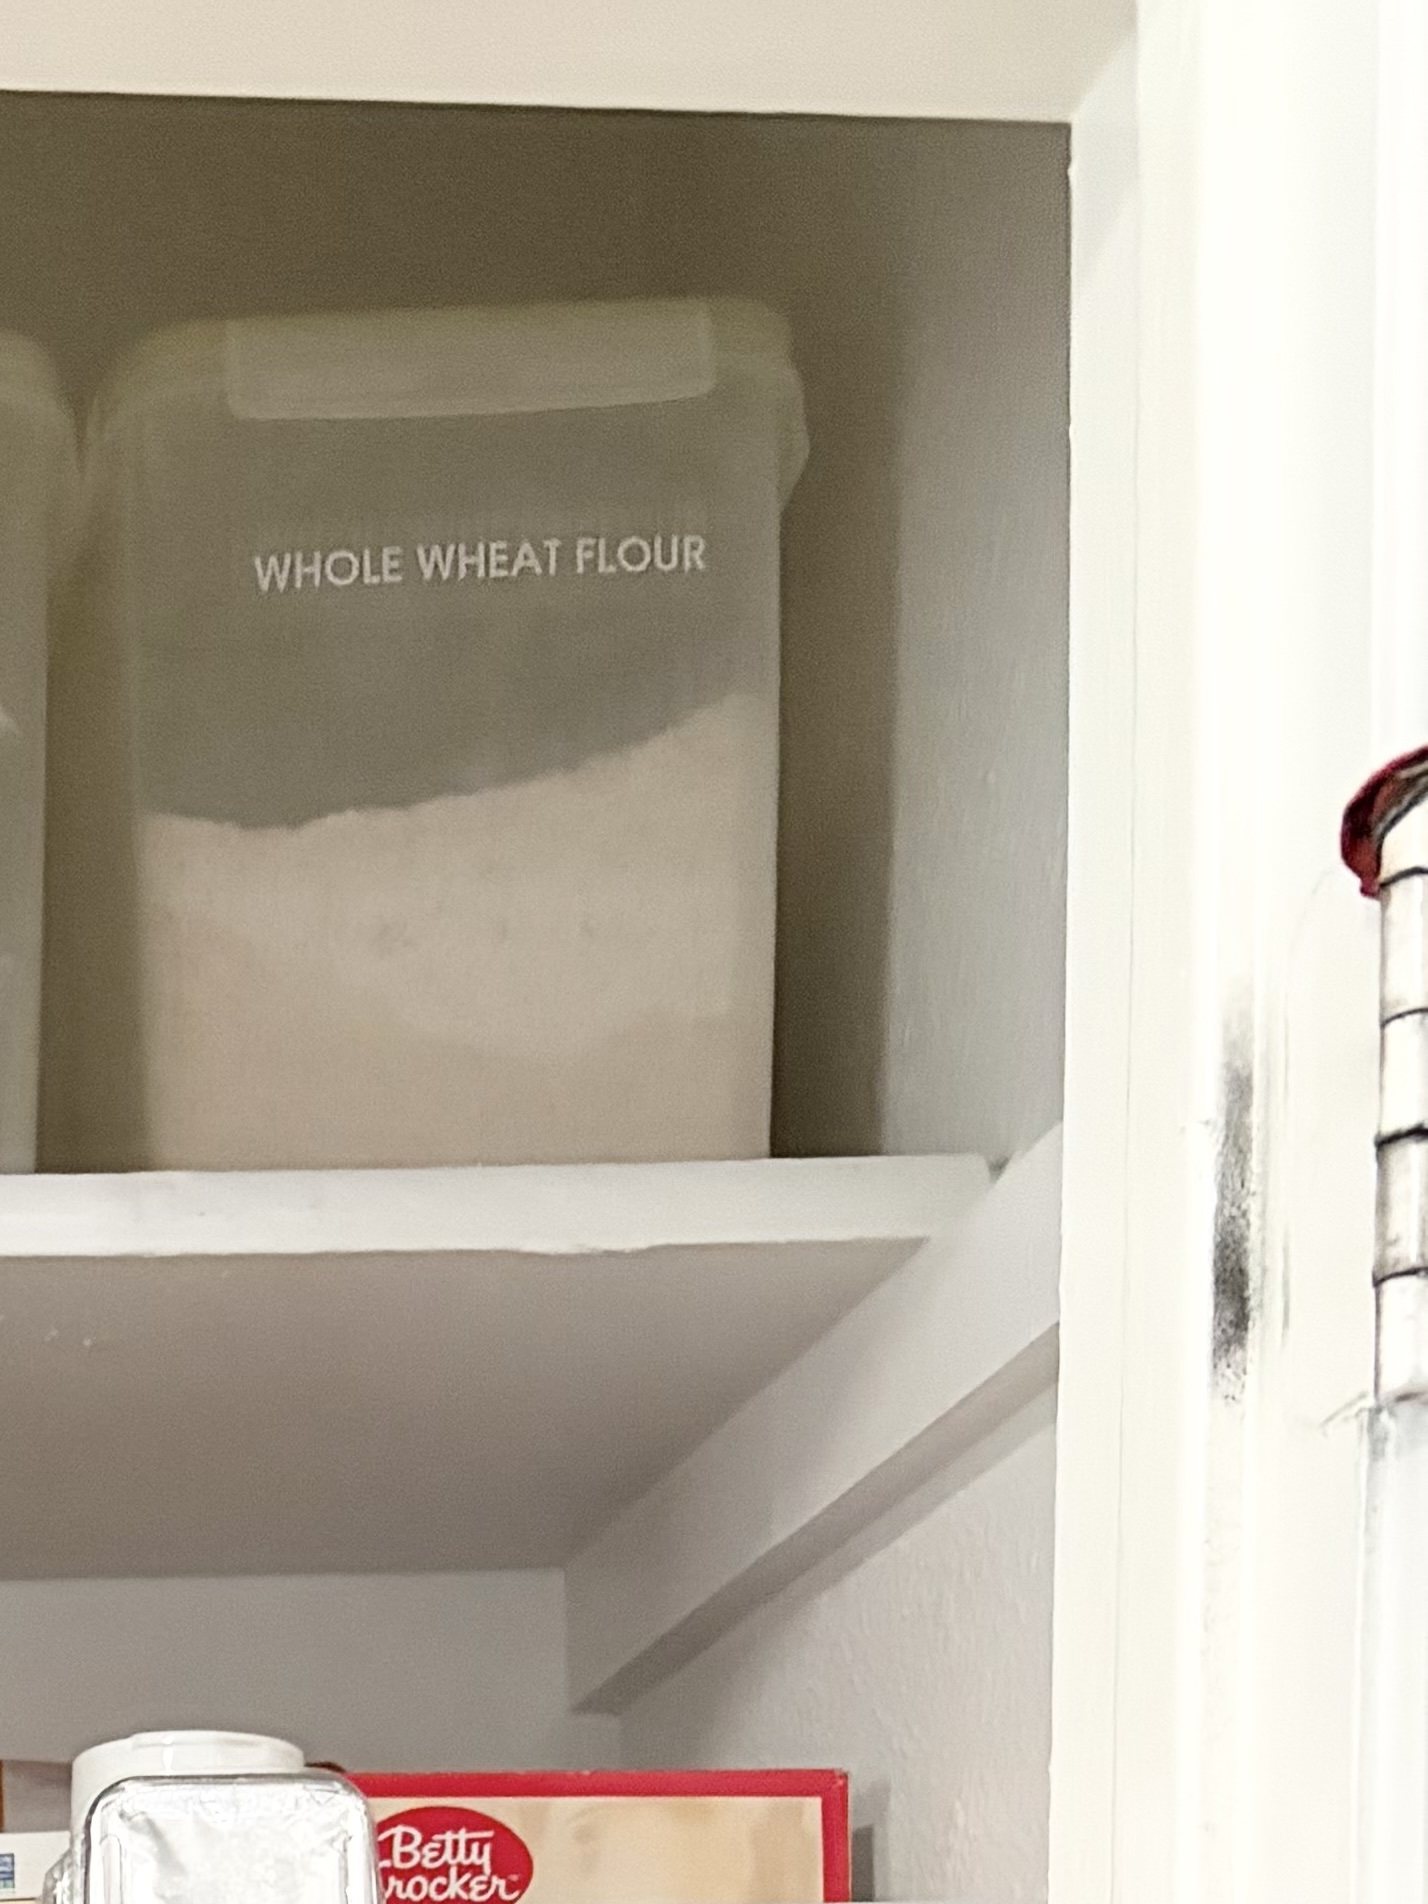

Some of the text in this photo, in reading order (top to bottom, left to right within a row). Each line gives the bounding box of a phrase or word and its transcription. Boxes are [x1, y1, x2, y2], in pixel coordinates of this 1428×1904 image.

[253, 534, 706, 592] WHOLE WHEAT FLOUR
[378, 1824, 494, 1870] Betty
[386, 1868, 518, 1903] rocker
